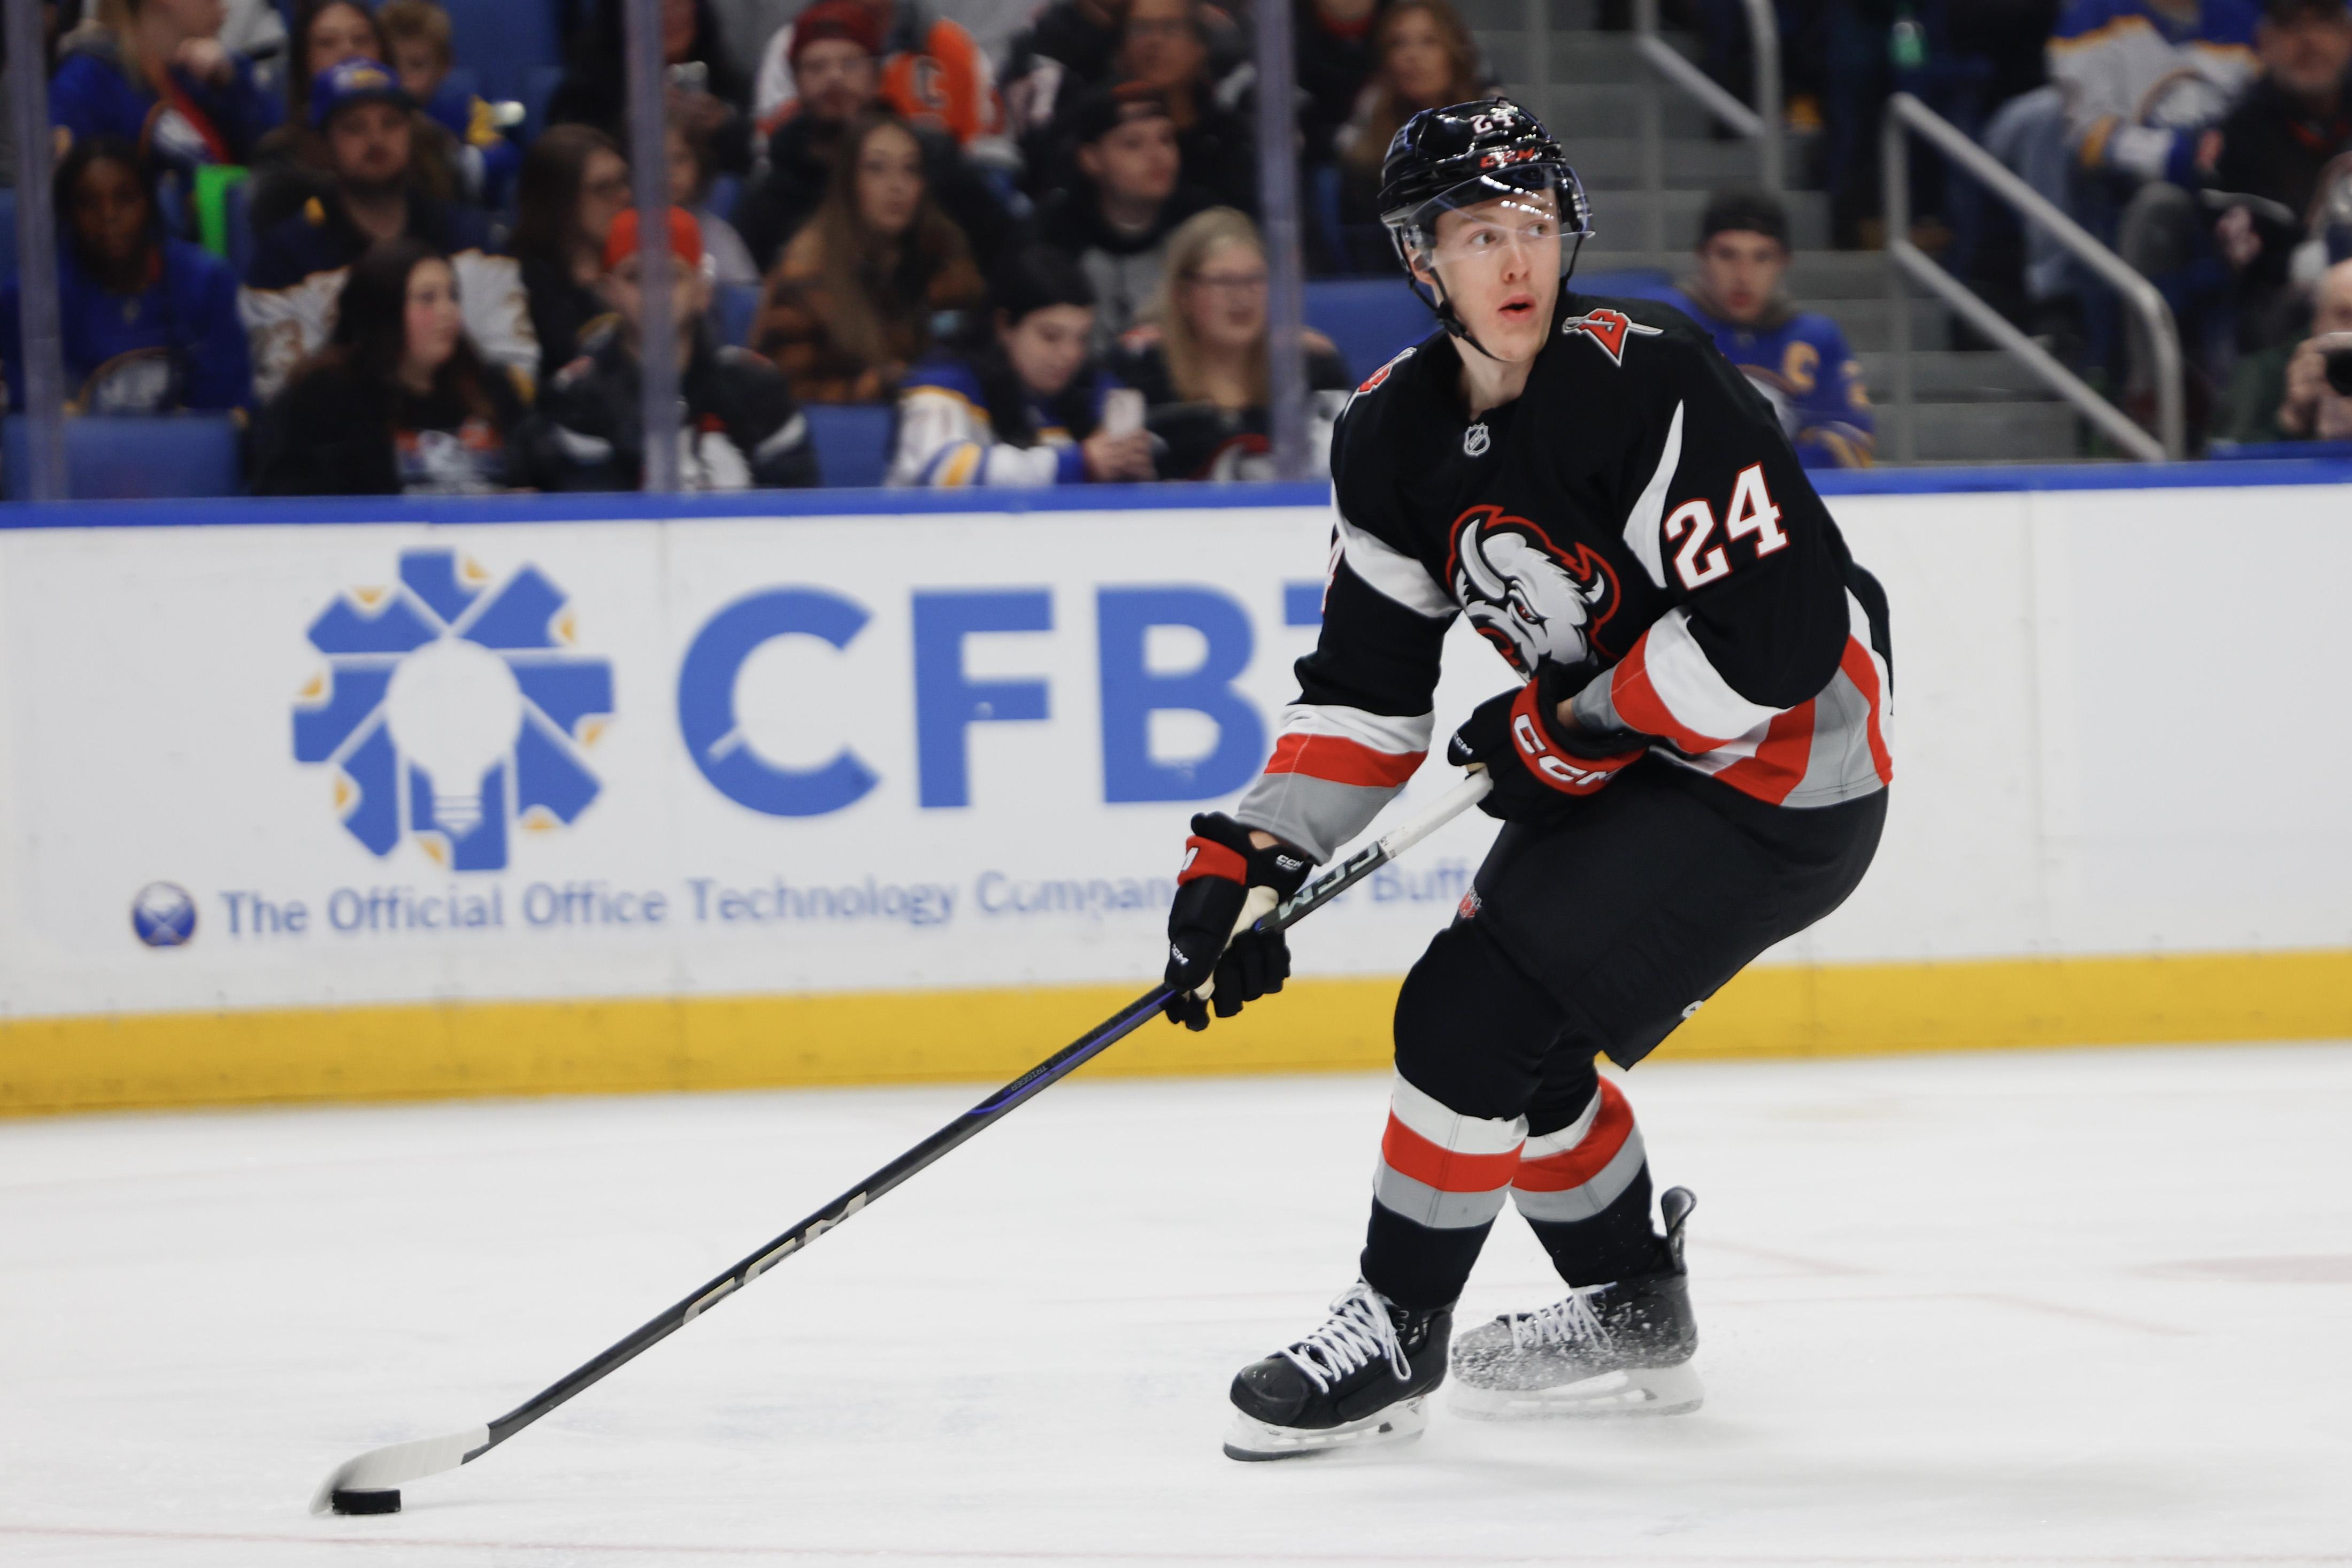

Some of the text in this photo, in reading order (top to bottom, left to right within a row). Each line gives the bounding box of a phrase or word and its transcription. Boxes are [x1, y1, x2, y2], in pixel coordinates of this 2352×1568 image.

[1469, 109, 1515, 134] 24
[1664, 461, 1790, 590] 24
[677, 582, 1326, 817] CFB
[218, 890, 310, 936] The
[327, 883, 505, 932] Official
[522, 880, 668, 927] Office
[686, 873, 955, 927] Technology
[974, 870, 1178, 921] Compan
[1011, 1064, 1049, 1092] TRIGGER
